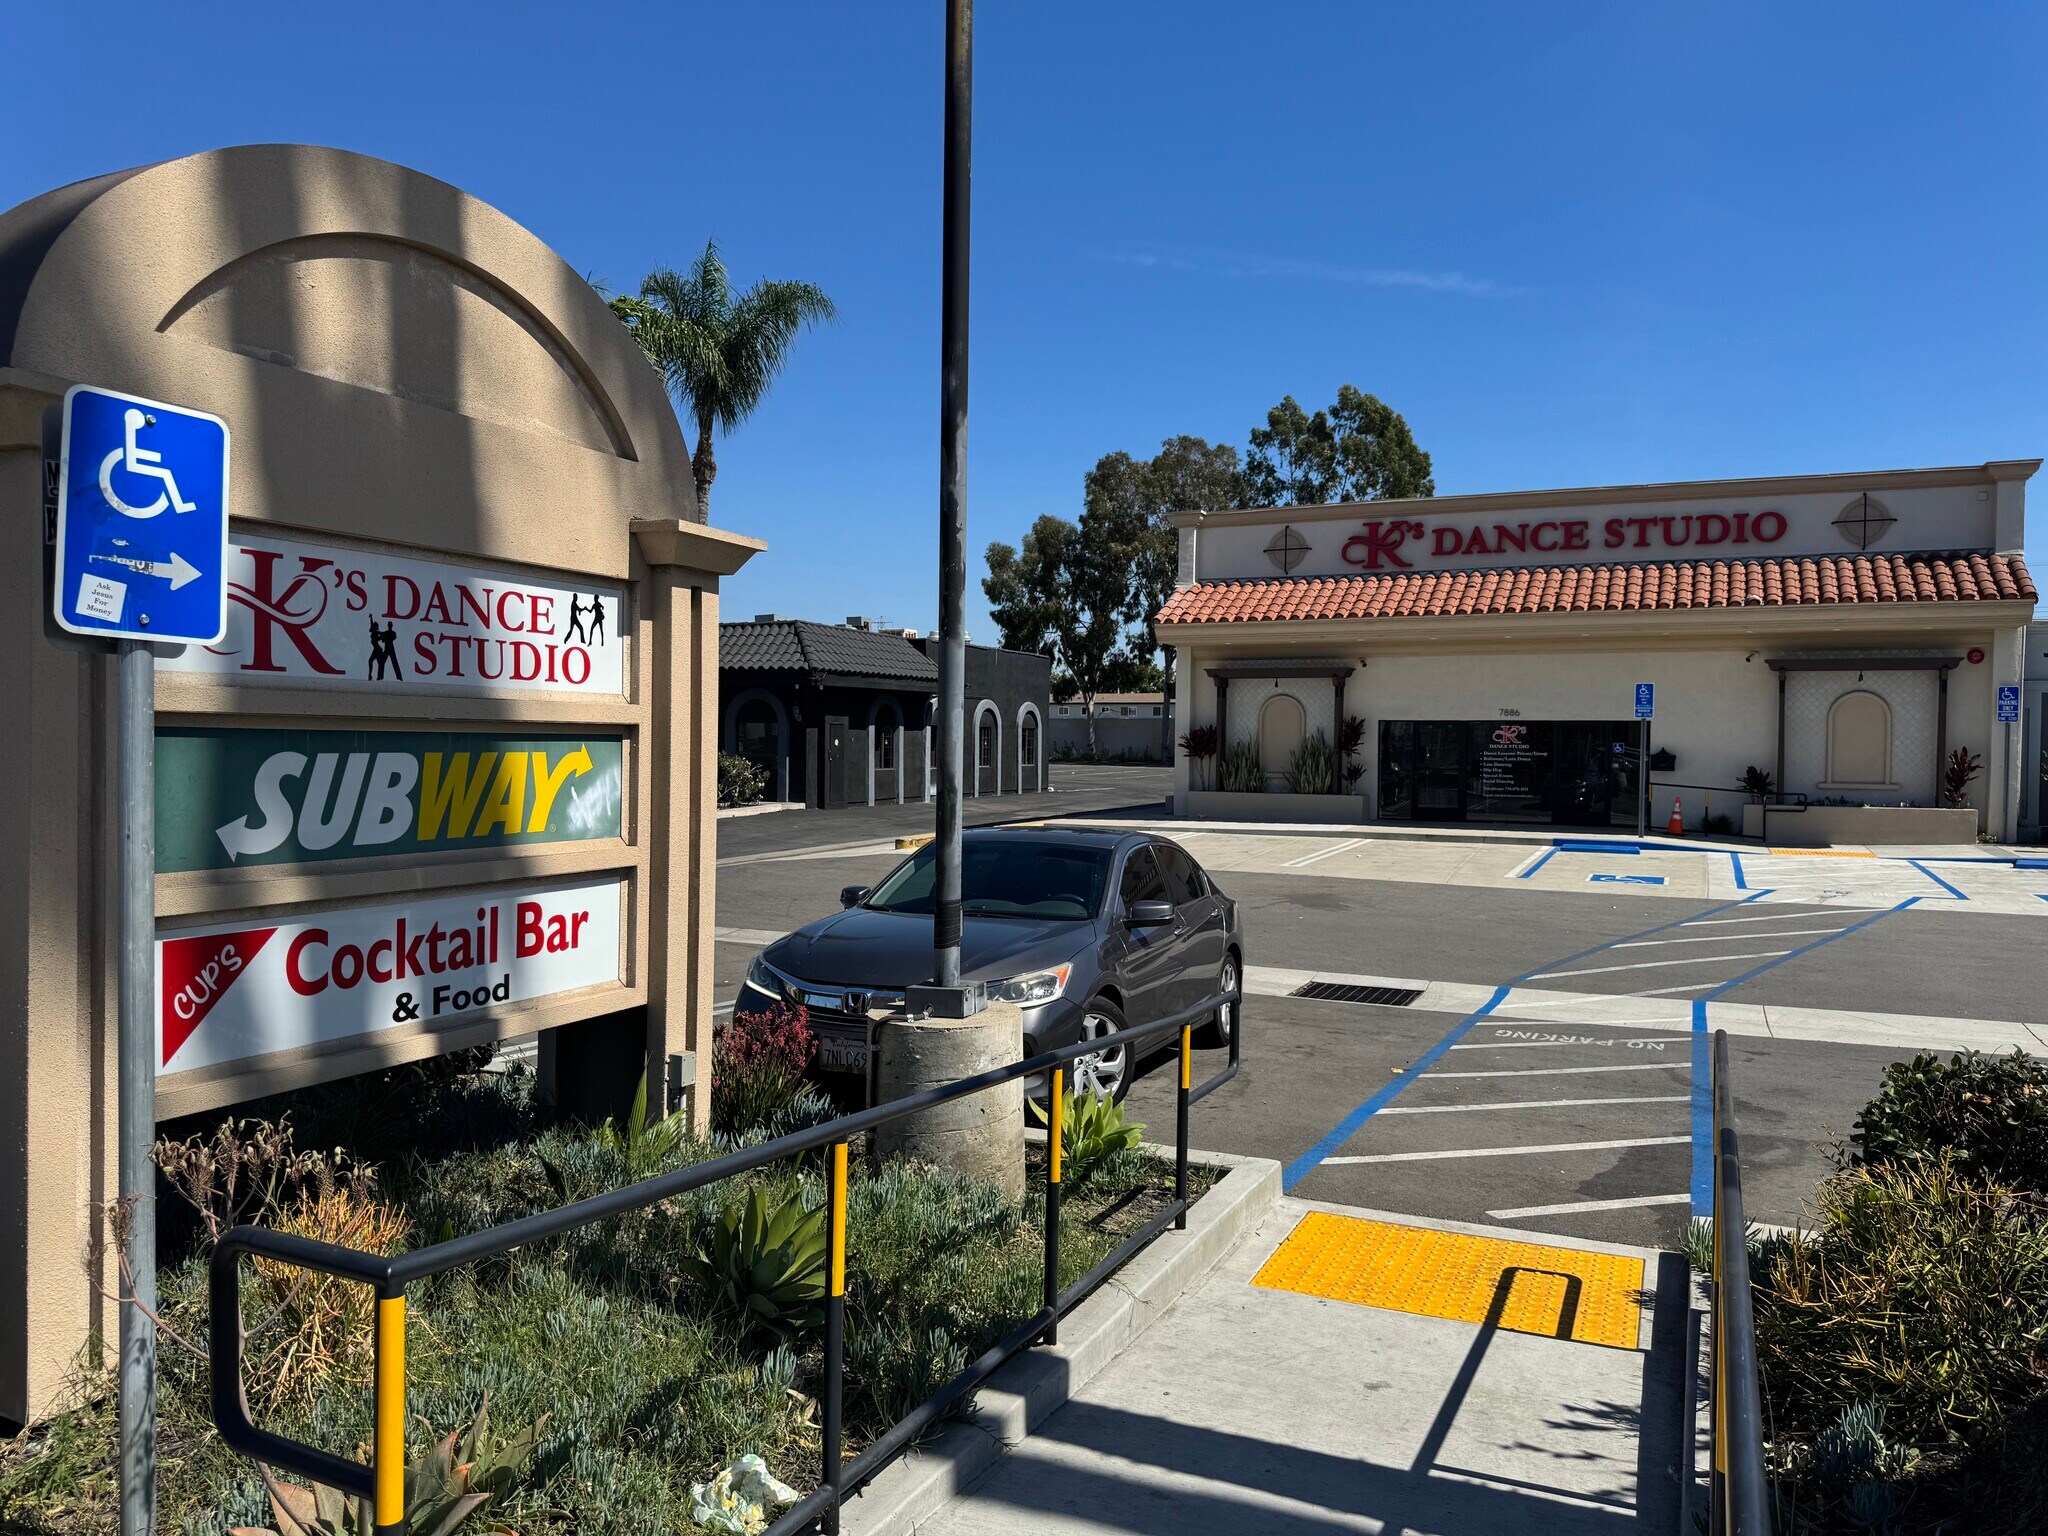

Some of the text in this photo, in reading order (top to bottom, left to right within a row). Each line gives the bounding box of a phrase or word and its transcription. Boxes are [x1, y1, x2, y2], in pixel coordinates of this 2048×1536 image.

[1431, 519, 1590, 557] DANCE
[1604, 511, 1788, 549] STUDIO
[91, 589, 113, 599] Jesus
[96, 582, 111, 591] Ask
[86, 604, 113, 616] Money
[94, 597, 109, 606] For
[381, 574, 556, 636] DANCE
[413, 631, 591, 685] STUDIO
[1499, 708, 1520, 717] 7886
[215, 743, 594, 863] SUBWAY
[285, 900, 590, 997] Cocktail Bar
[173, 943, 243, 1020] CUP'S
[391, 973, 511, 1023] & Food
[832, 1040, 867, 1050] California
[1494, 1028, 1666, 1051] NO PARKING
[824, 1048, 868, 1068] 7NLC69
